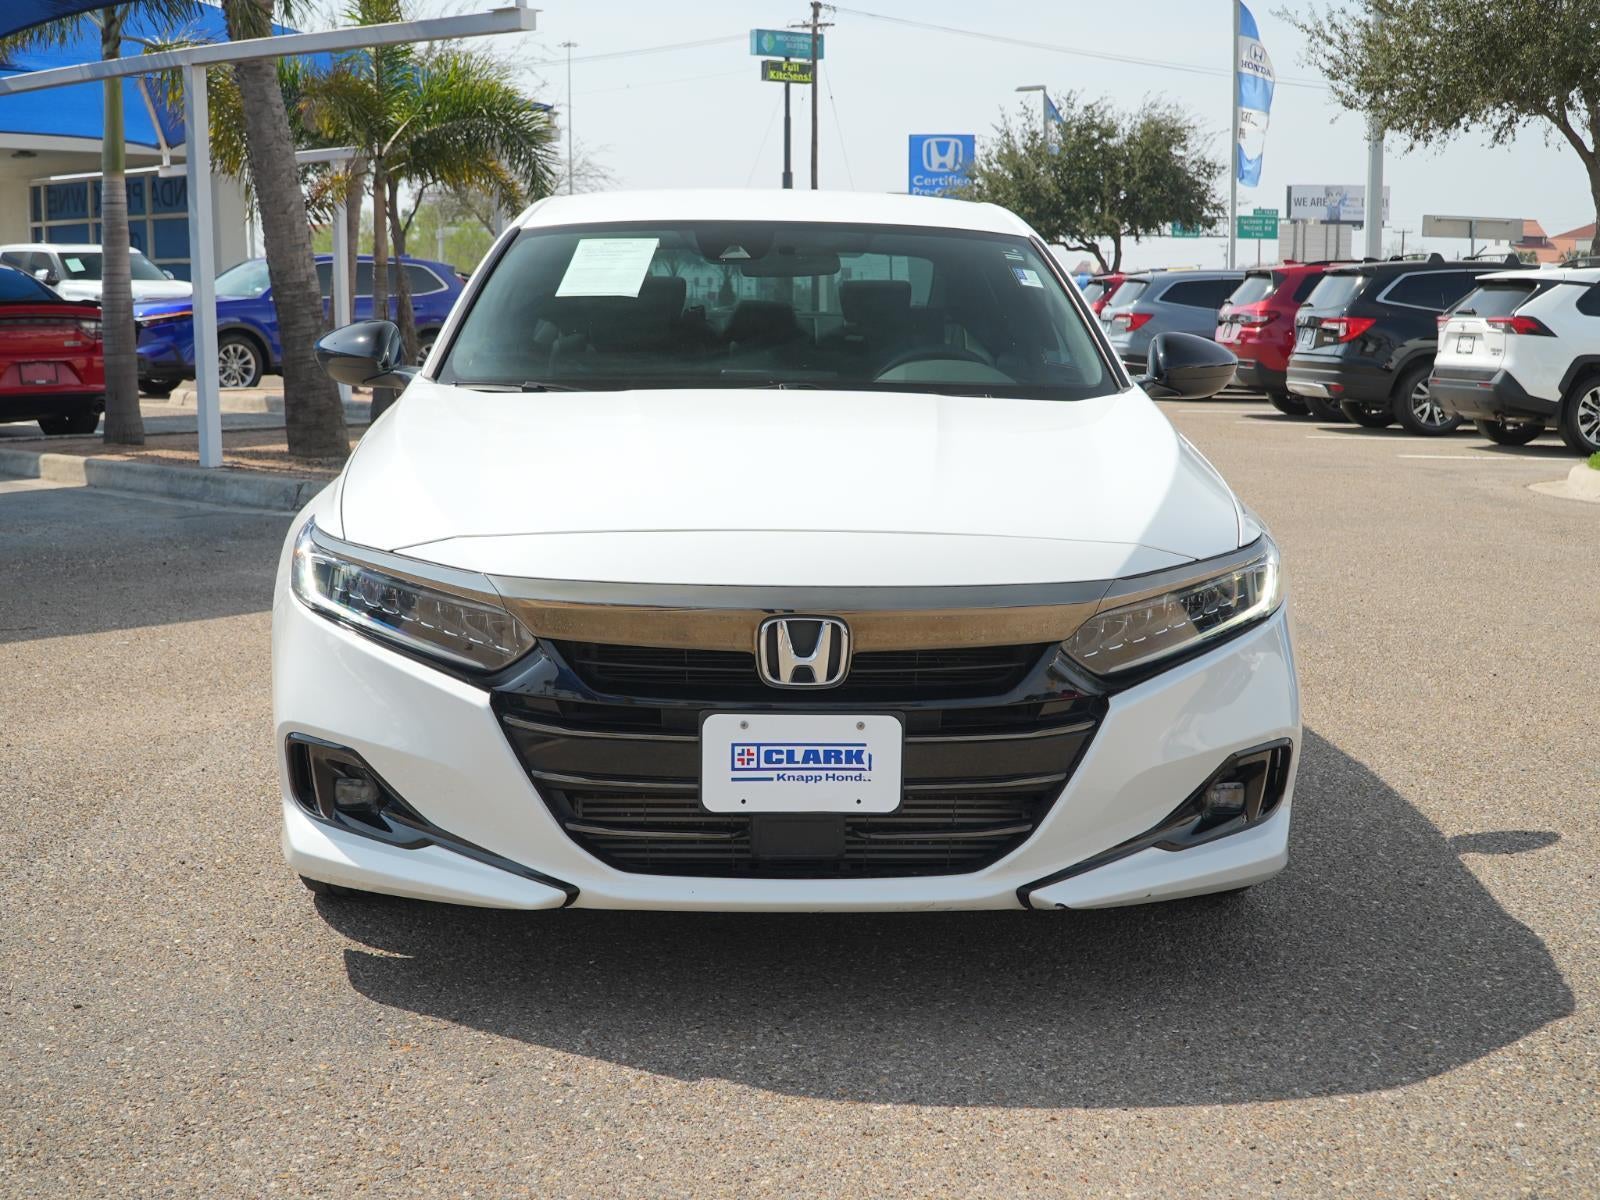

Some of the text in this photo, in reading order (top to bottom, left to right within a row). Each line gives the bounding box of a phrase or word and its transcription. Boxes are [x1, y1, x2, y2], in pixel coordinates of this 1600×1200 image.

[783, 61, 800, 71] Full
[1240, 59, 1272, 77] HONDA
[769, 70, 812, 81] Kitchens!
[1294, 197, 1328, 208] WE ARE
[763, 749, 866, 765] CLARK
[776, 773, 872, 783] Knapp Hond
